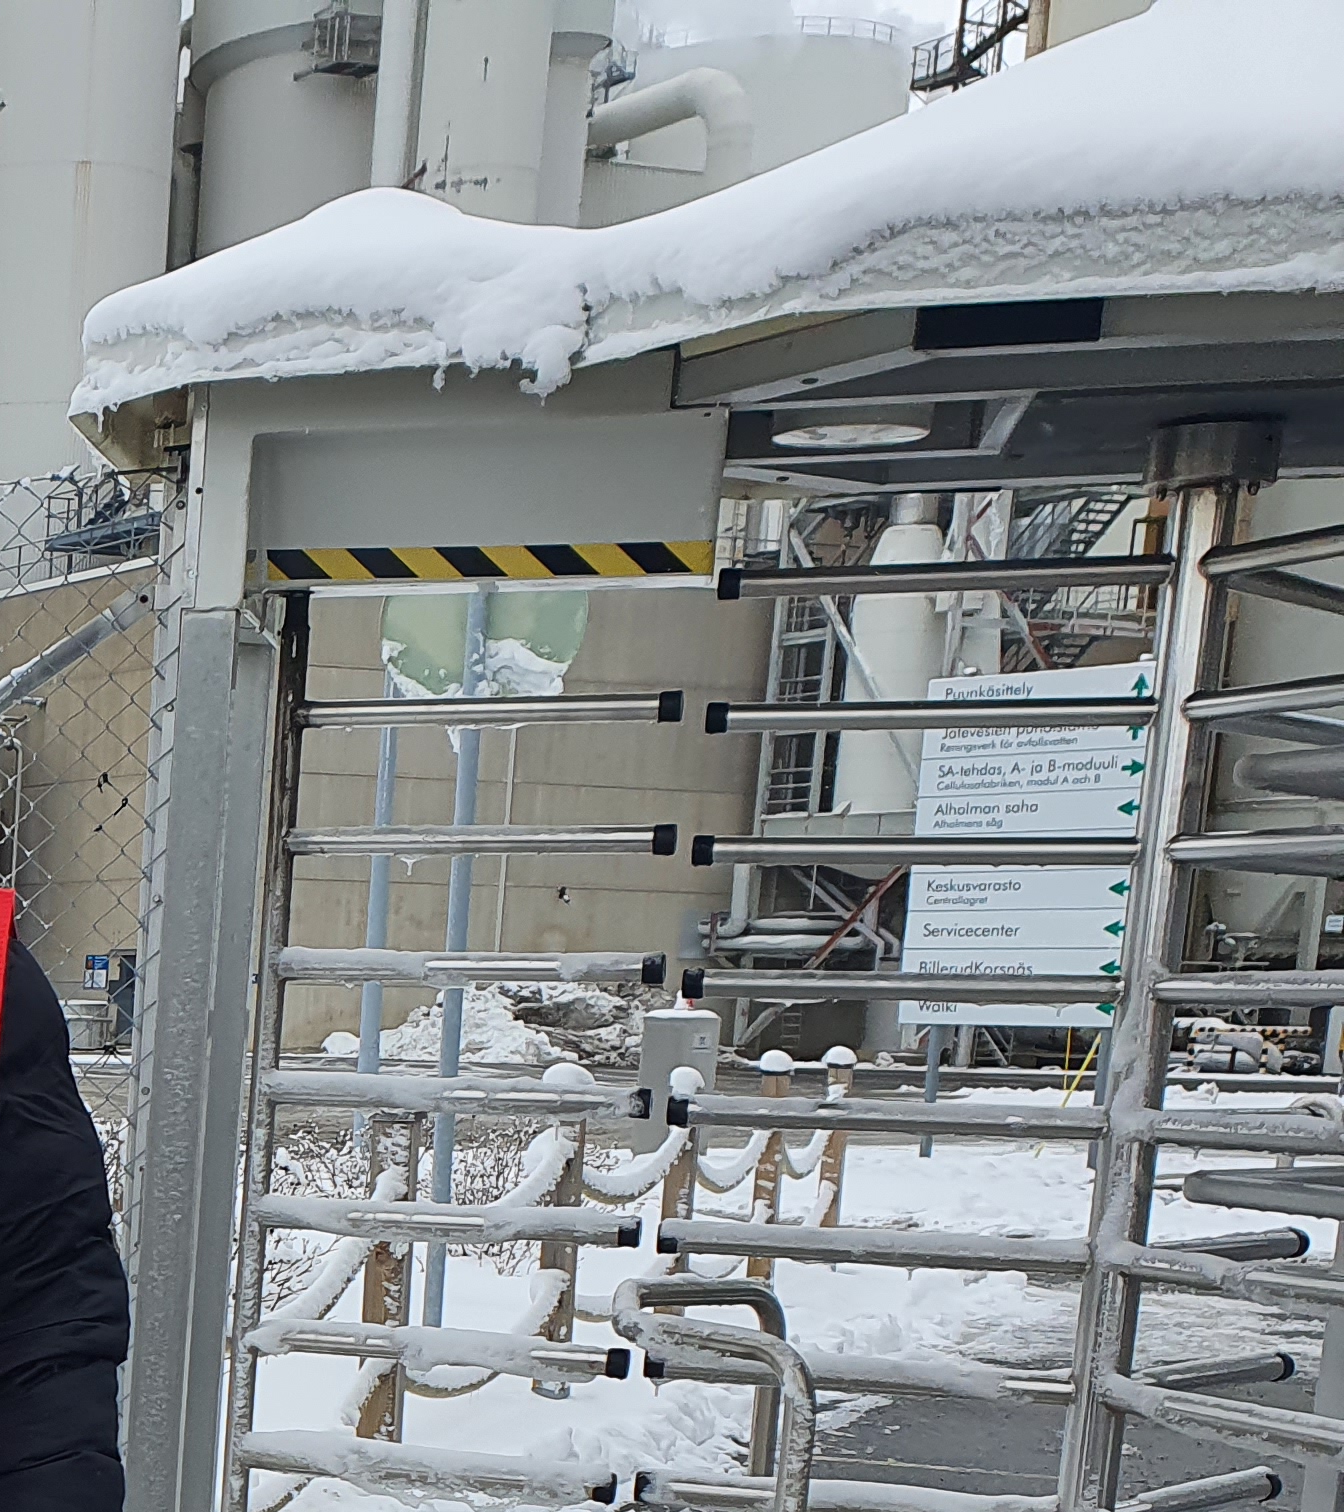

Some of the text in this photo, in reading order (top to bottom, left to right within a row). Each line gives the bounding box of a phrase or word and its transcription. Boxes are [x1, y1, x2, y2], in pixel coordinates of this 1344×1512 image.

[938, 763, 1006, 778] SA-tehdas,
[1031, 760, 1042, 776] ja
[1048, 755, 1118, 772] B-moduuli
[934, 800, 1038, 816] Alholman saha
[927, 879, 1021, 892] Keskusvarasto
[923, 923, 1020, 937] Servicecenter
